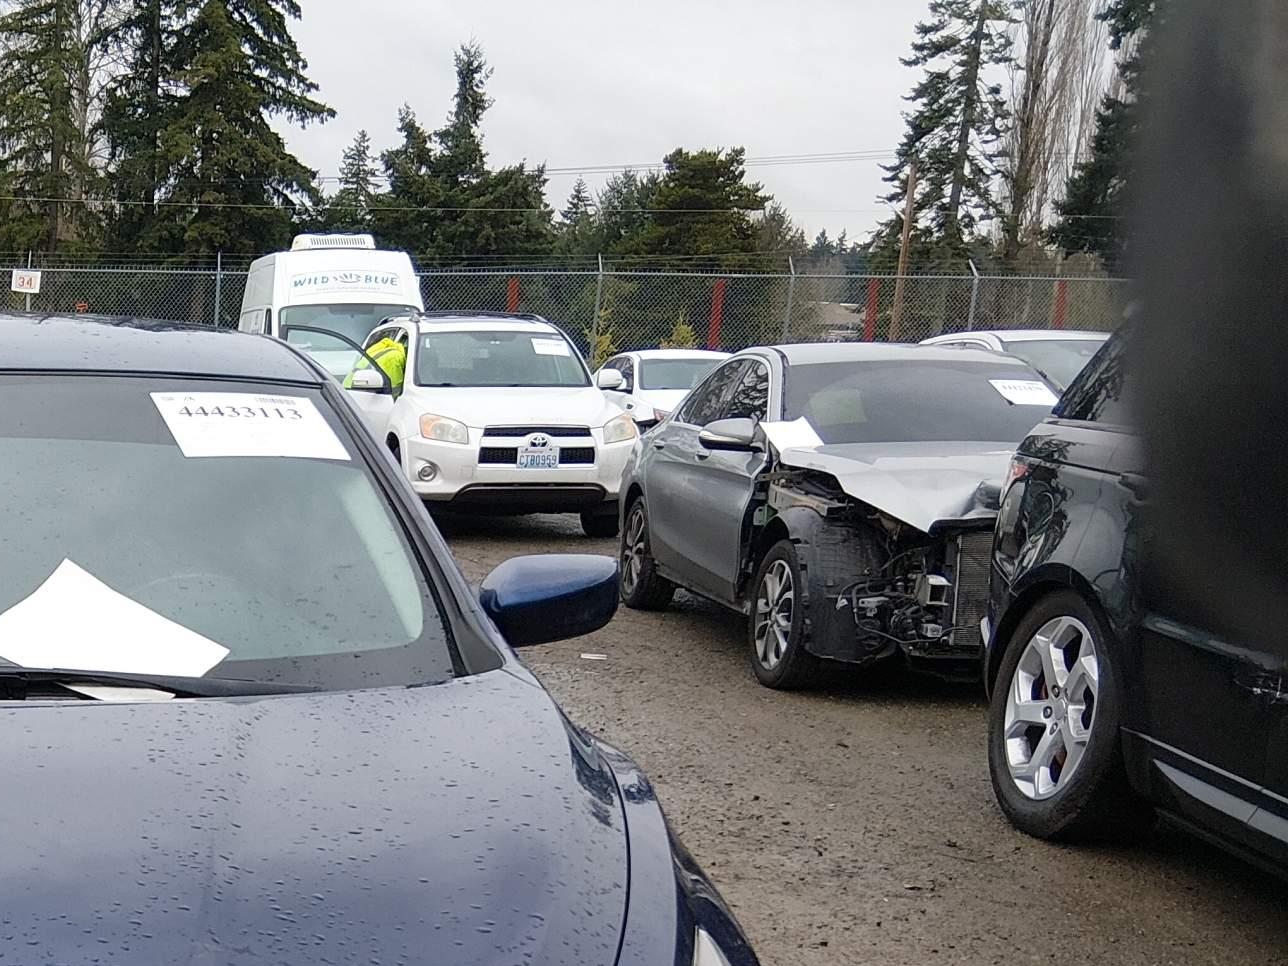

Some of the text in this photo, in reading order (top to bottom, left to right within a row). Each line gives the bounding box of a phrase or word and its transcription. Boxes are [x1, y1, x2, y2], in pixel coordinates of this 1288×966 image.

[17, 276, 33, 288] 34
[293, 274, 399, 288] WILD BLUE
[178, 404, 304, 421] 44433113
